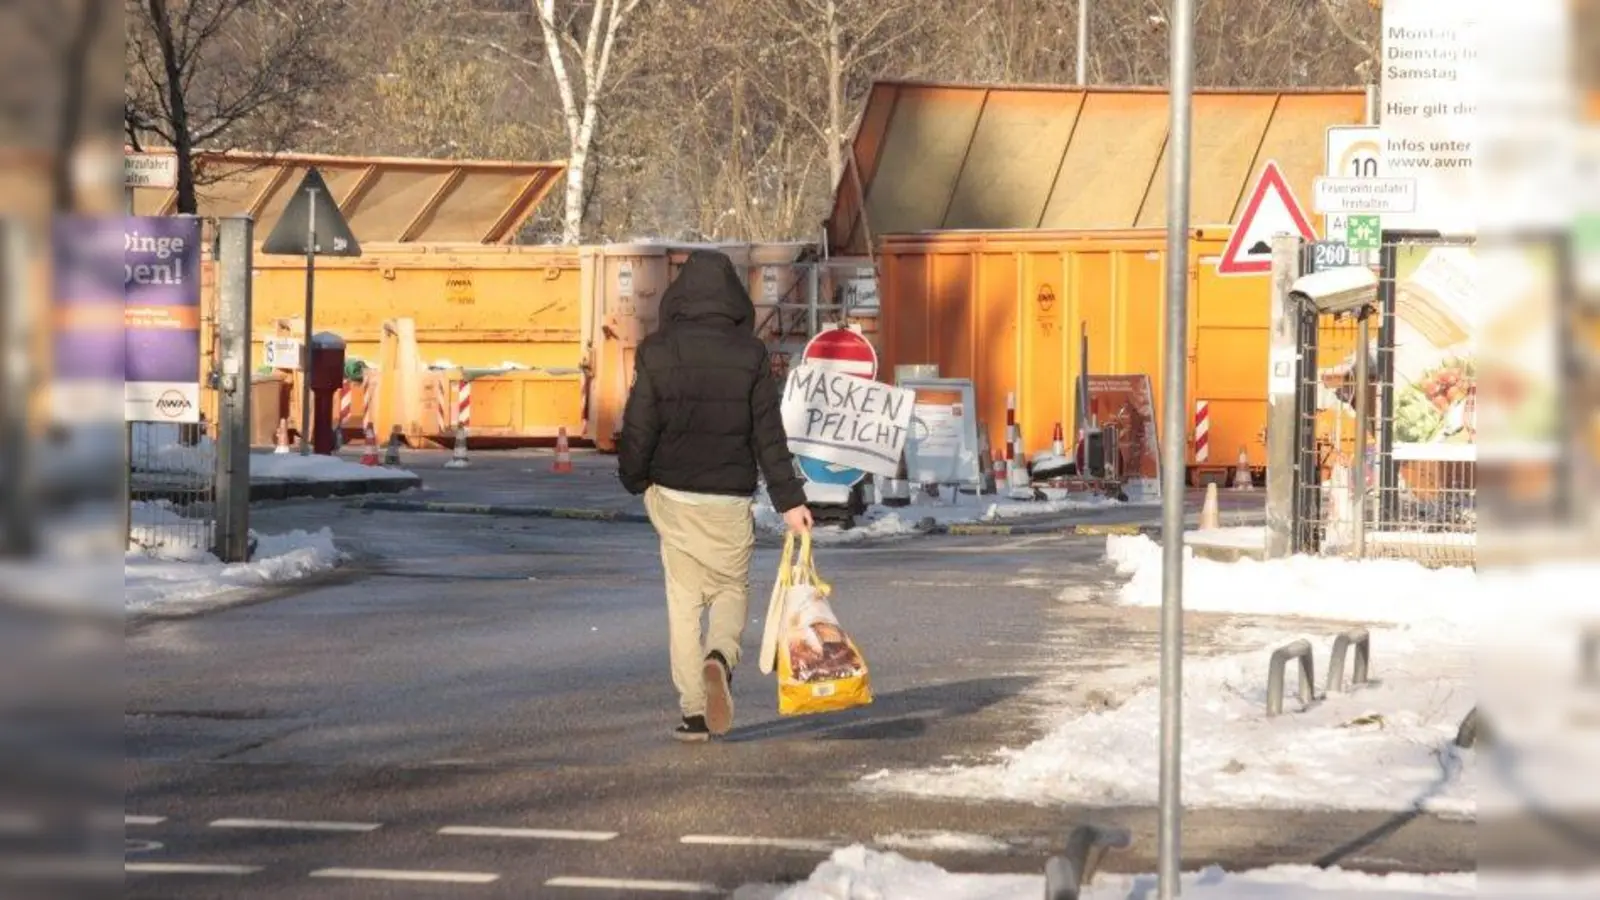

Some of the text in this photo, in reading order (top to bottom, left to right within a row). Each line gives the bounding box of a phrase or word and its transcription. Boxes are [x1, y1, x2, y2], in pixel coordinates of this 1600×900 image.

[1388, 26, 1456, 41] Montag
[1388, 46, 1457, 60] Dienstag
[1387, 65, 1457, 81] Samstag
[1387, 102, 1418, 115] Hier
[1423, 102, 1447, 118] gilt
[1387, 138, 1471, 151] Infos unter
[1388, 158, 1472, 168] www.awm
[1315, 245, 1346, 264] 260
[788, 369, 904, 421] MASKEN
